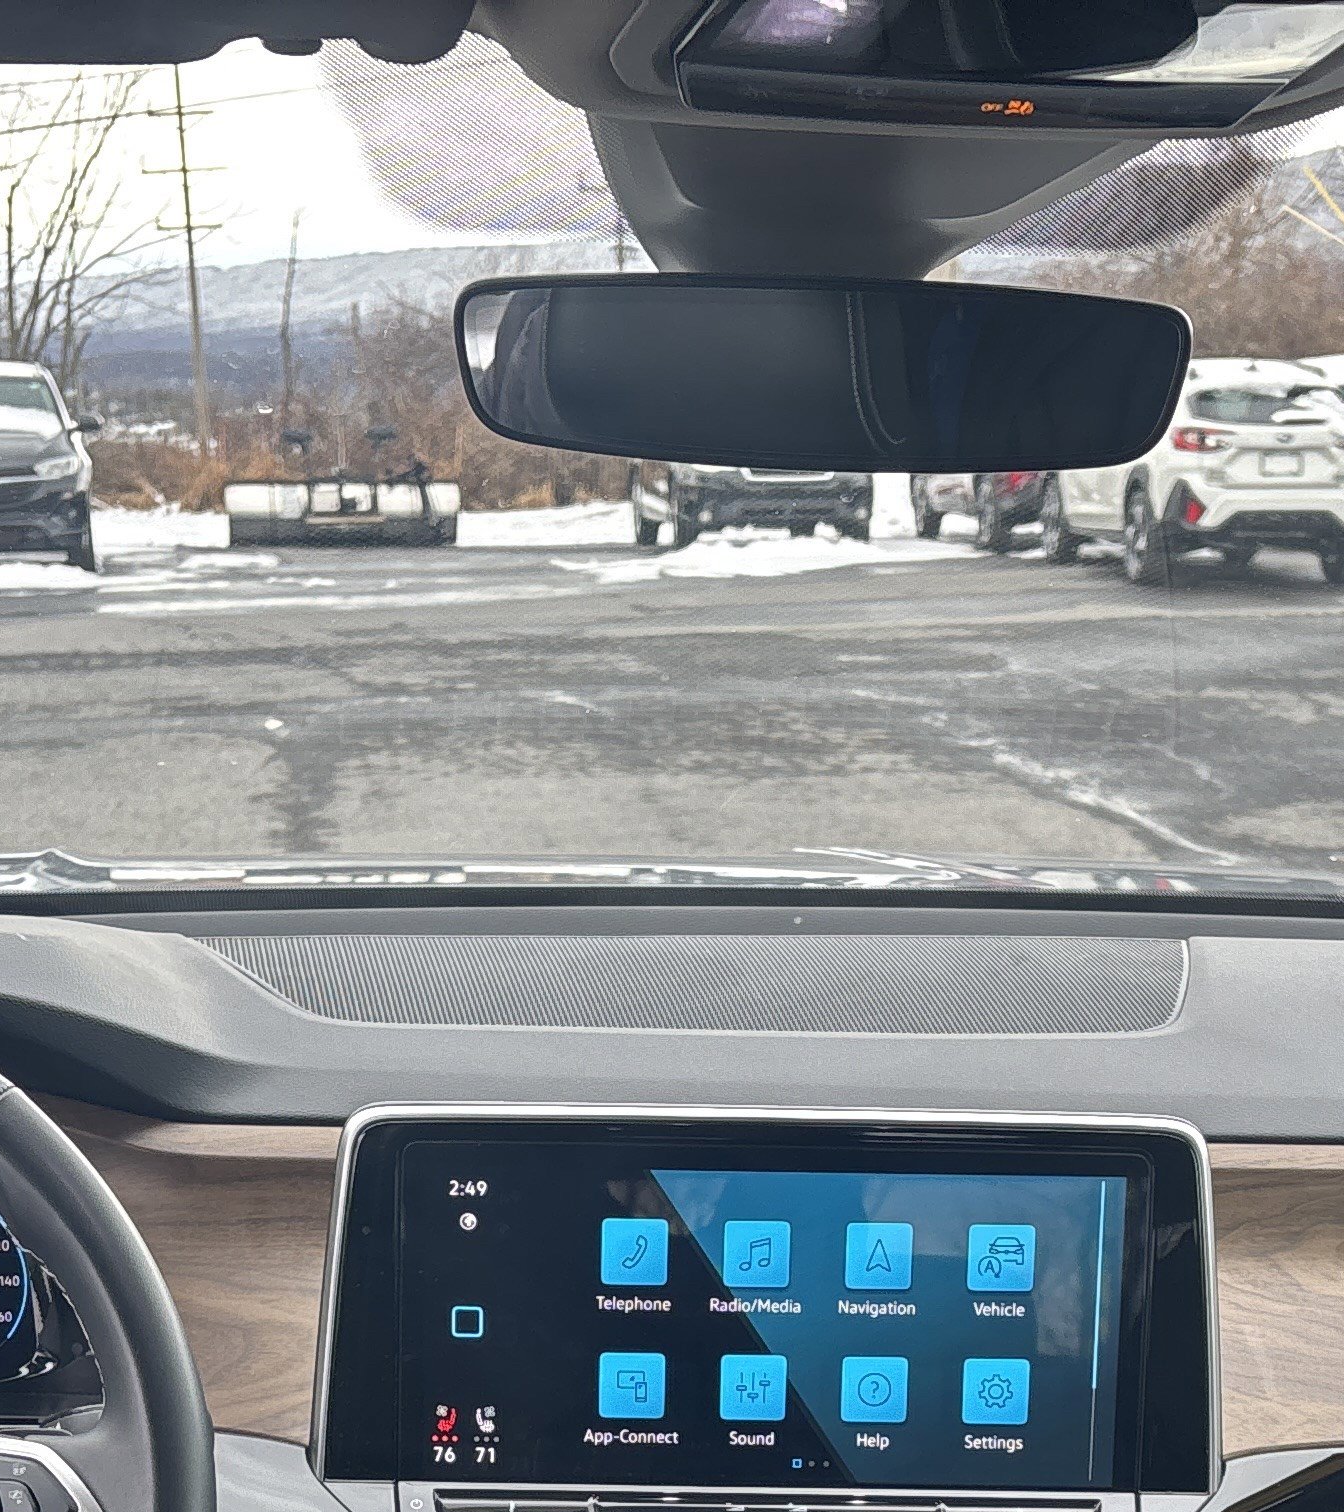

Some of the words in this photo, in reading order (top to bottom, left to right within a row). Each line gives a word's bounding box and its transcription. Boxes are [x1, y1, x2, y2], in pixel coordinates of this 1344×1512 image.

[448, 1180, 488, 1197] 2:49
[595, 1295, 672, 1314] Telephone
[709, 1297, 802, 1314] Radio/Media
[837, 1300, 917, 1318] Navigation
[973, 1301, 1026, 1318] Vehicle
[583, 1428, 680, 1446] App-Connect
[728, 1430, 775, 1446] Sound
[856, 1433, 890, 1451] Help
[964, 1434, 1024, 1453] Settings
[433, 1446, 457, 1463] 76
[475, 1446, 496, 1464] 71
